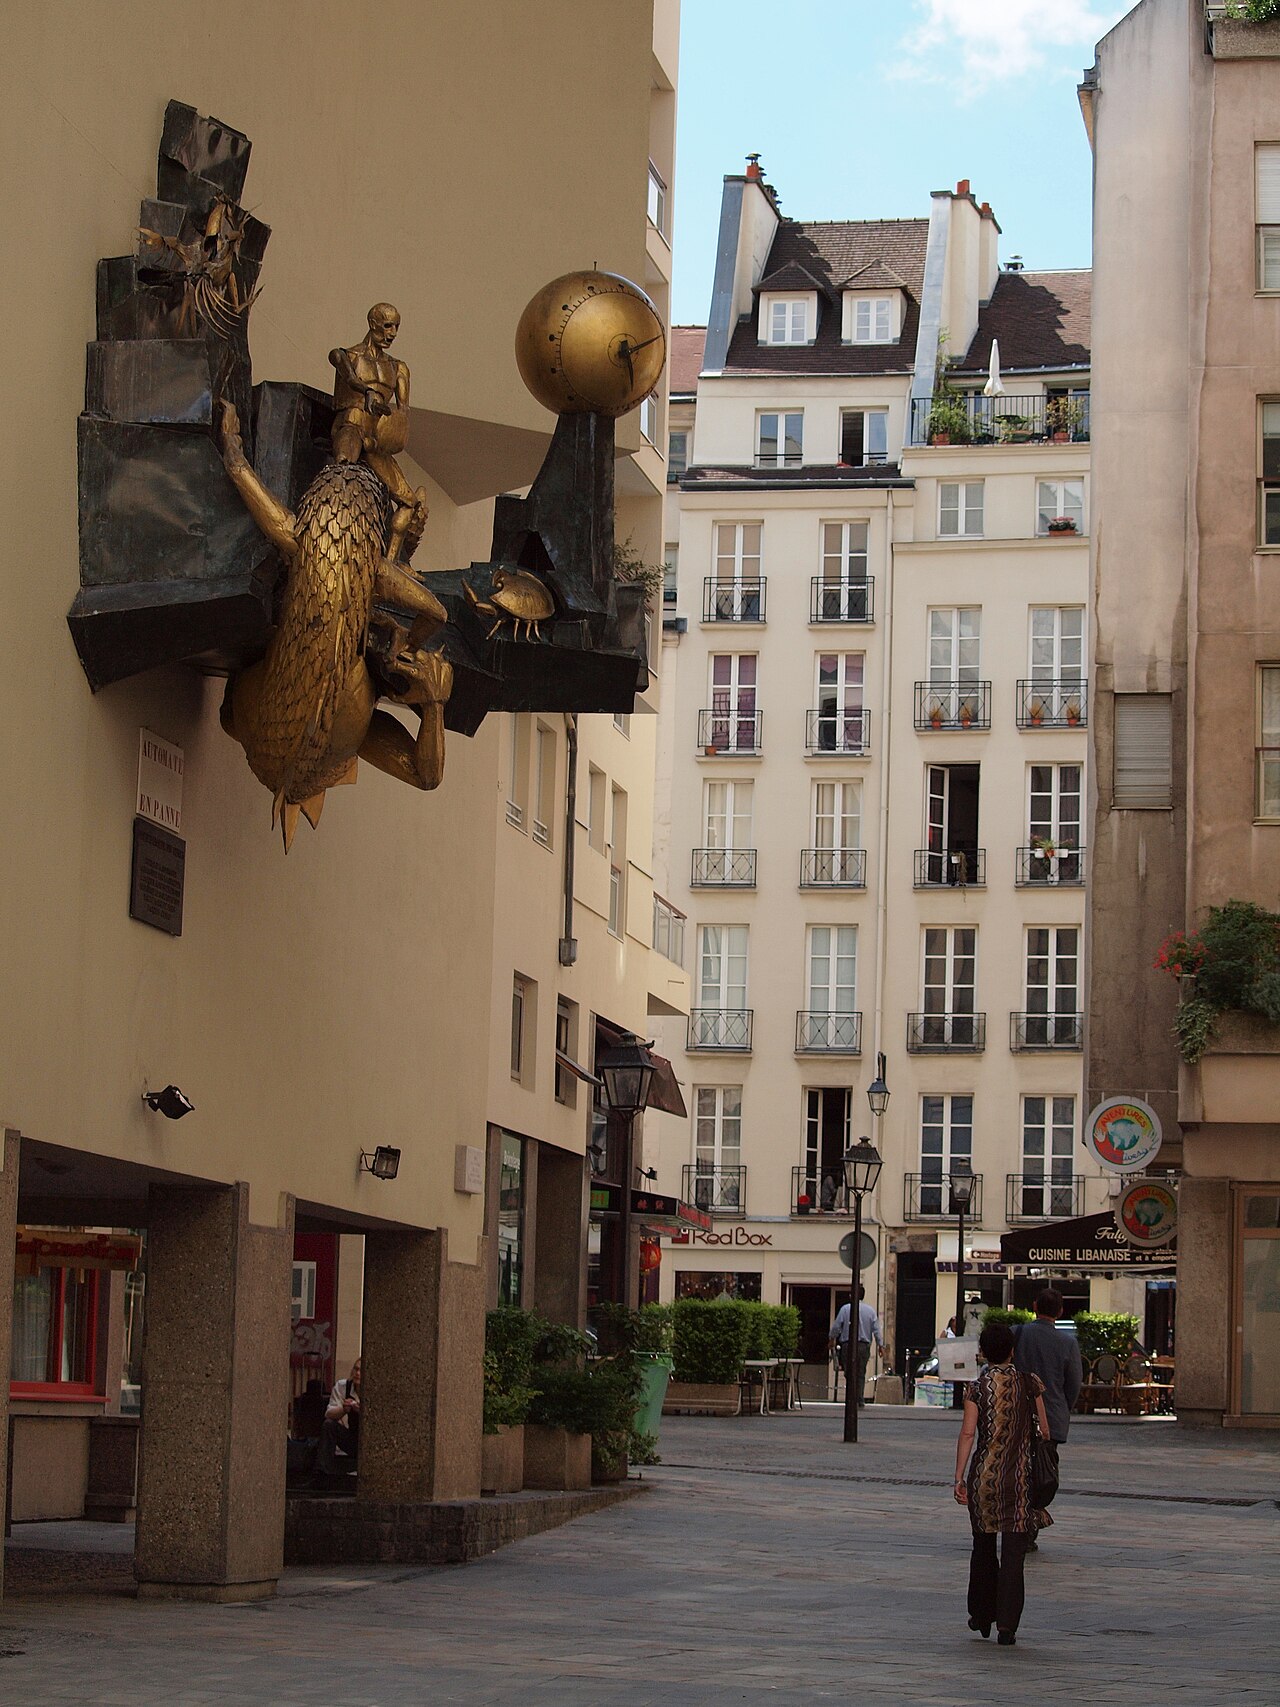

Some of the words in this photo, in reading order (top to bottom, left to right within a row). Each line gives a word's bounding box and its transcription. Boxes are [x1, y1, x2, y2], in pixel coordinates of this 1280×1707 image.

[142, 740, 184, 775] AUTOMATE
[140, 793, 152, 813] EN
[153, 799, 180, 828] PANNE
[1101, 1108, 1147, 1128] AVENTURES
[693, 1228, 733, 1245] Red
[735, 1226, 773, 1246] Box
[1028, 1248, 1071, 1261] CUISINE
[1076, 1248, 1131, 1261] LIBANAISE
